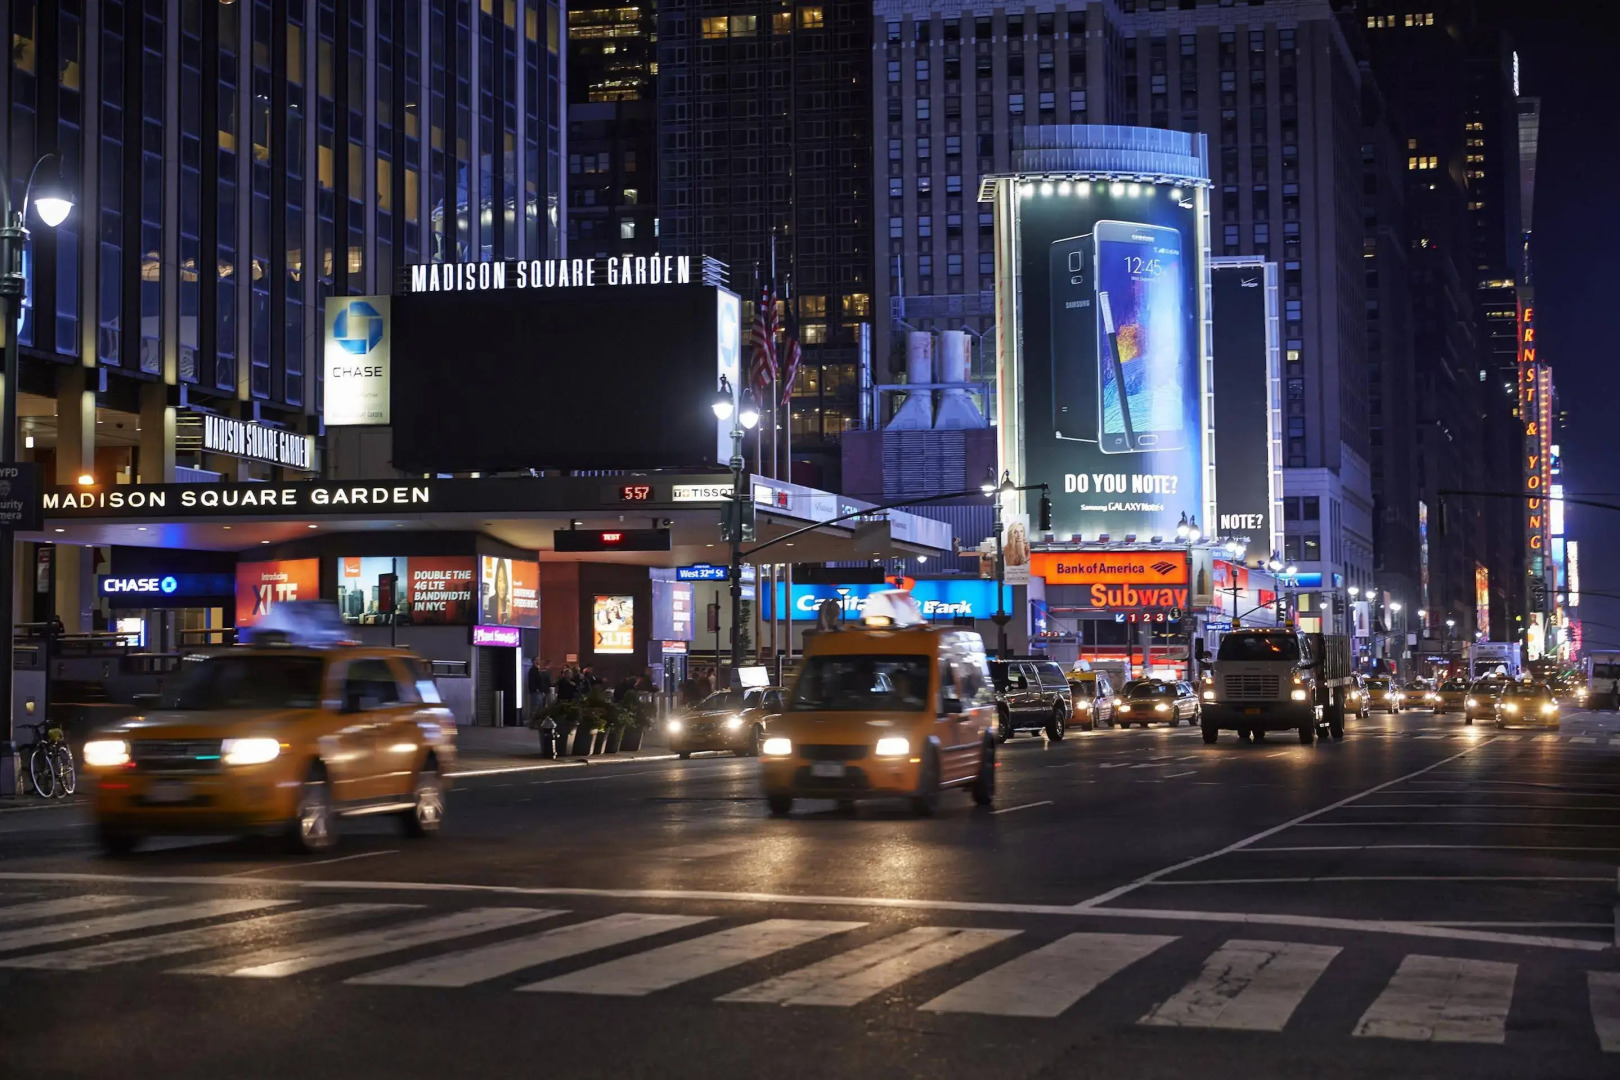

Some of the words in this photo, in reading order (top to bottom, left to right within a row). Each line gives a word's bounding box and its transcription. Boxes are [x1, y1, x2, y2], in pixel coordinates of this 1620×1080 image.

[1123, 256, 1161, 277] 12:45
[412, 264, 505, 292] MADISON
[517, 259, 595, 289] SQUARE
[608, 255, 690, 286] GARDEN
[1523, 307, 1535, 402] ERNST
[333, 366, 383, 378] CHASE
[205, 415, 245, 455] MADISON
[247, 423, 279, 461] SQUARE
[280, 432, 310, 468] GARDEN
[1064, 473, 1089, 493] DO
[1092, 473, 1127, 493] YOU
[1131, 474, 1178, 494] NOTE?
[43, 491, 166, 510] MADISON
[181, 489, 298, 507] SQUARE
[311, 486, 430, 505] GARDEN
[692, 488, 733, 498] TISSOT
[1108, 502, 1141, 511] GALAXY
[1527, 455, 1542, 549] YOUNG
[1221, 514, 1263, 530] NOTE?
[680, 569, 699, 578] West
[715, 569, 724, 578] St
[1057, 563, 1086, 574] Bank
[1086, 563, 1097, 574] of
[1099, 563, 1145, 574] America
[414, 570, 452, 581] DOUBLE
[453, 570, 472, 581] THE
[104, 578, 159, 592] CHASE
[414, 581, 427, 590] 4G
[428, 581, 445, 590] LTE
[414, 591, 471, 601] BANDWIDTH
[1090, 583, 1188, 609] Subway
[414, 602, 426, 611] IN
[427, 602, 446, 611] NYC
[923, 601, 972, 614] Bank
[1130, 613, 1136, 622] 1
[1143, 613, 1151, 622] 2
[1156, 613, 1164, 622] 3
